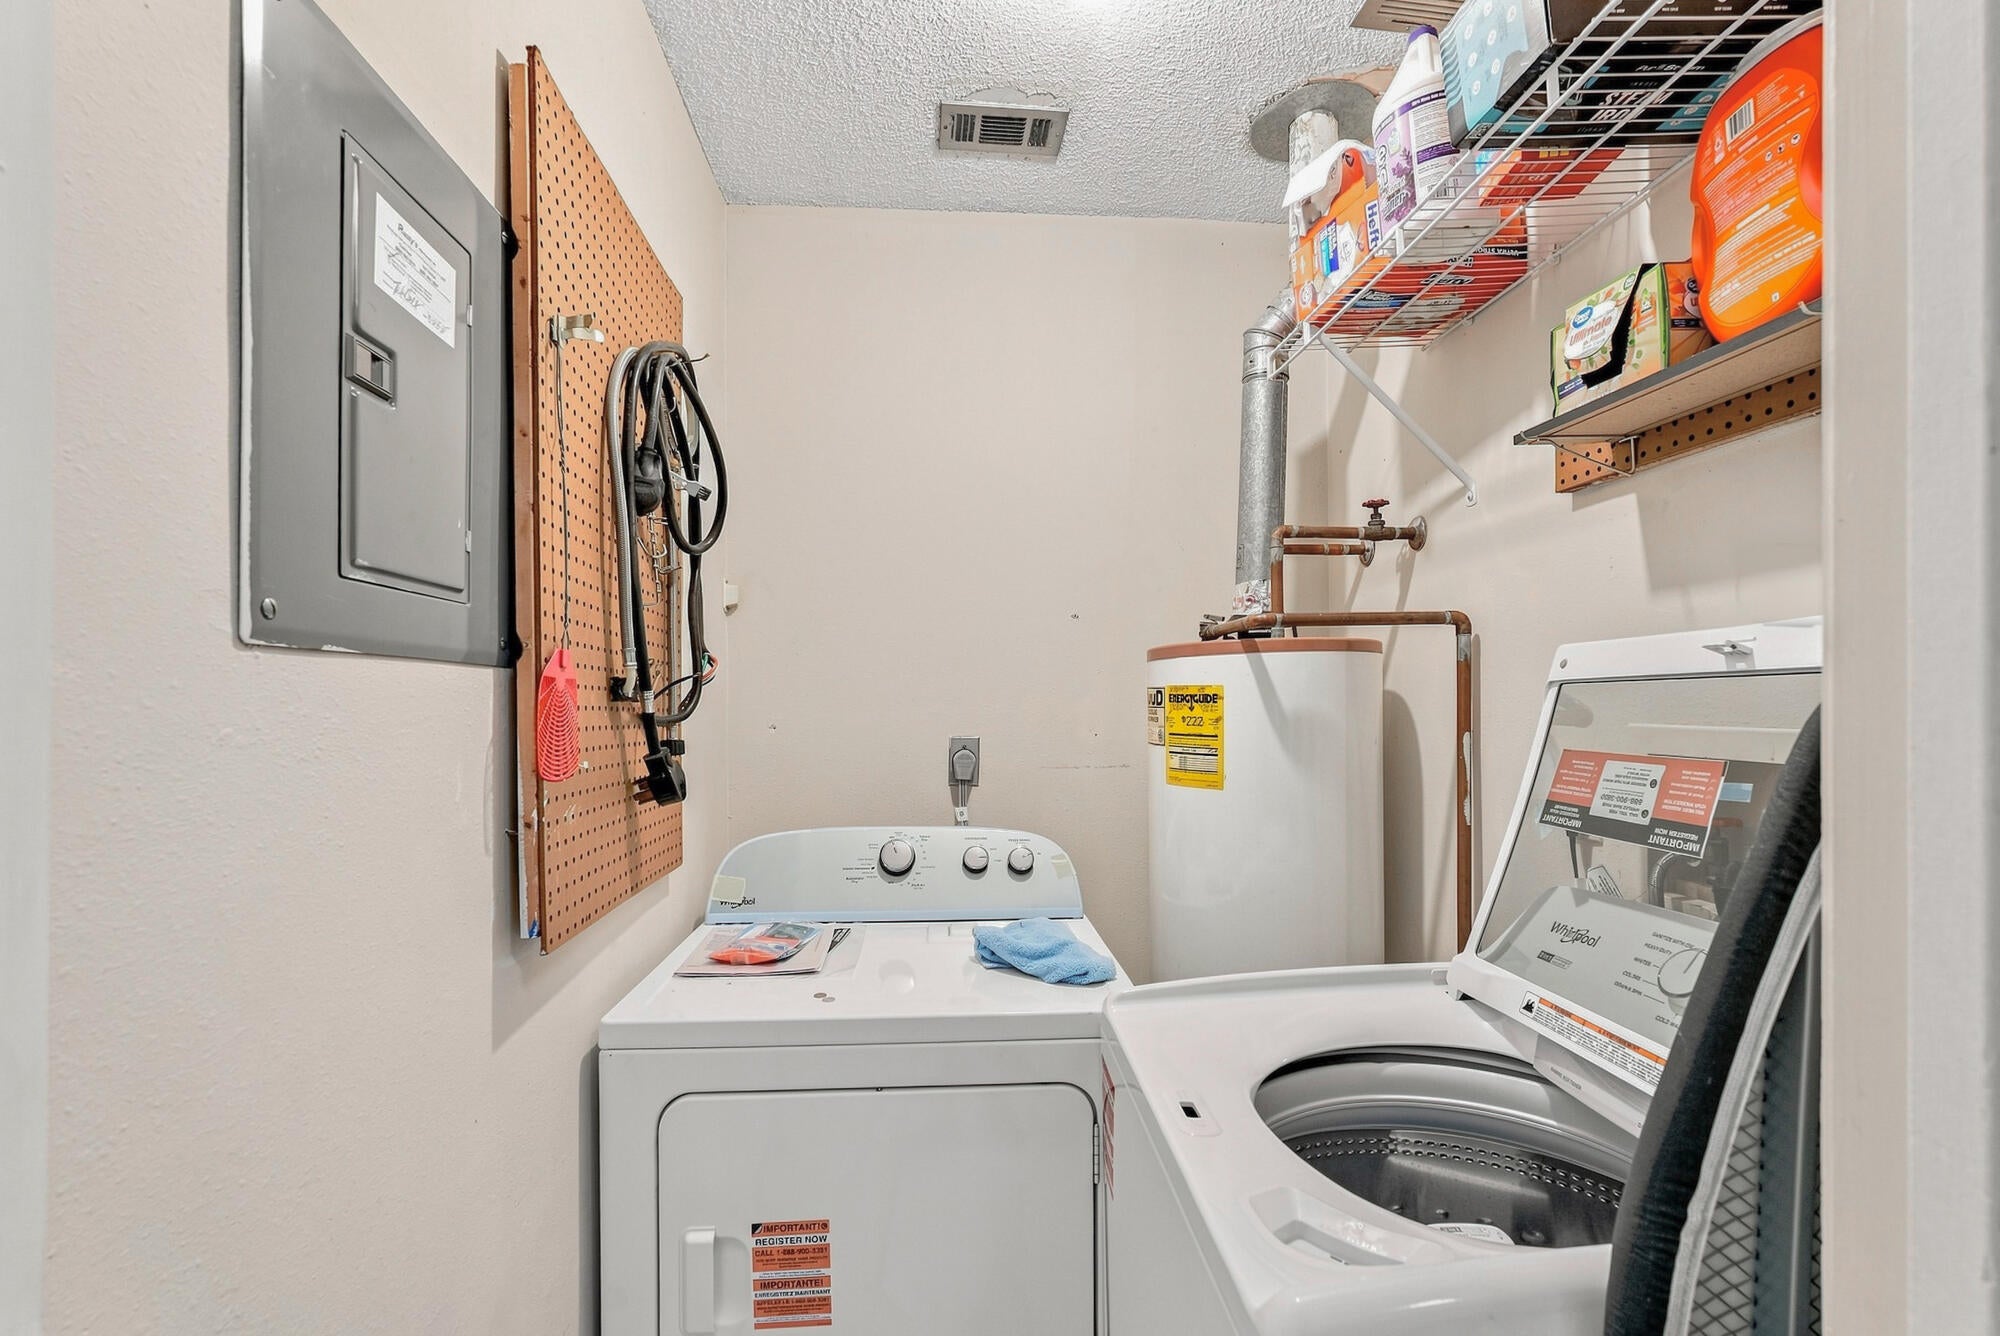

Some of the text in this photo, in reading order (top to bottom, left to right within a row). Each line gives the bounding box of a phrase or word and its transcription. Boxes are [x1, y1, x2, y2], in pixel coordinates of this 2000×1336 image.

[1367, 203, 1381, 251] Heft
[1542, 814, 1583, 828] IMPORTANT
[1648, 834, 1701, 852] IMPORTANT
[1550, 920, 1602, 948] Whirlpool
[763, 1222, 821, 1233] IMPORTANT!
[755, 1235, 828, 1246] REGISTER NOW
[754, 1249, 774, 1257] CALL
